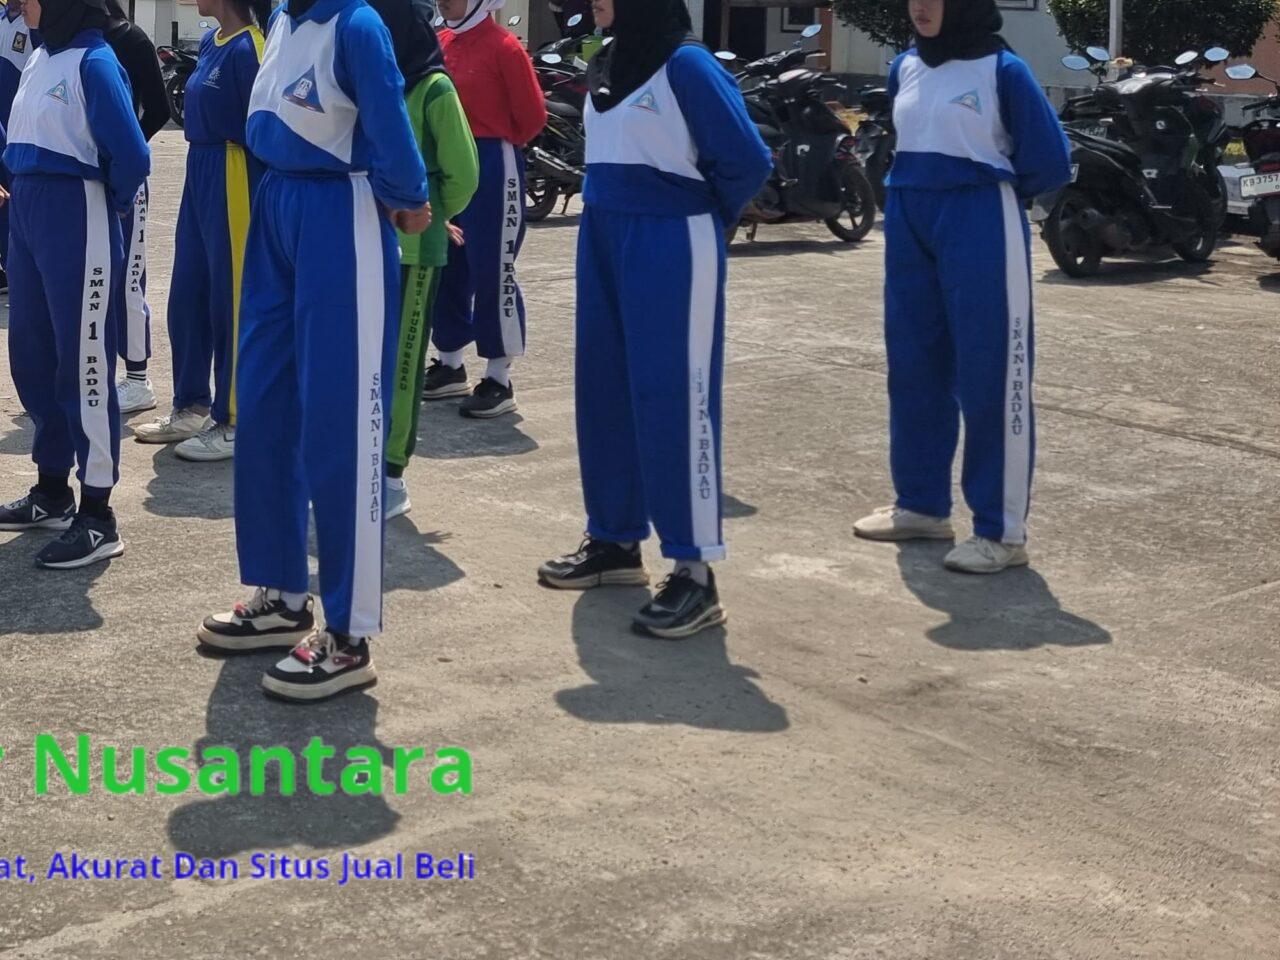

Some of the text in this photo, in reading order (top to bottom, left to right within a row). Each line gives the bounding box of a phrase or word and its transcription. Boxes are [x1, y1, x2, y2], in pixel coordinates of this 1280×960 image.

[131, 190, 146, 292] SMAN 1 BADAU
[503, 178, 518, 318] SMAN 1 BADAU
[86, 267, 104, 407] SMAN 1 BADAU
[370, 373, 381, 523] SMAN 1 BADAU
[1011, 381, 1023, 435] BADAU
[698, 439, 710, 500] BADAU
